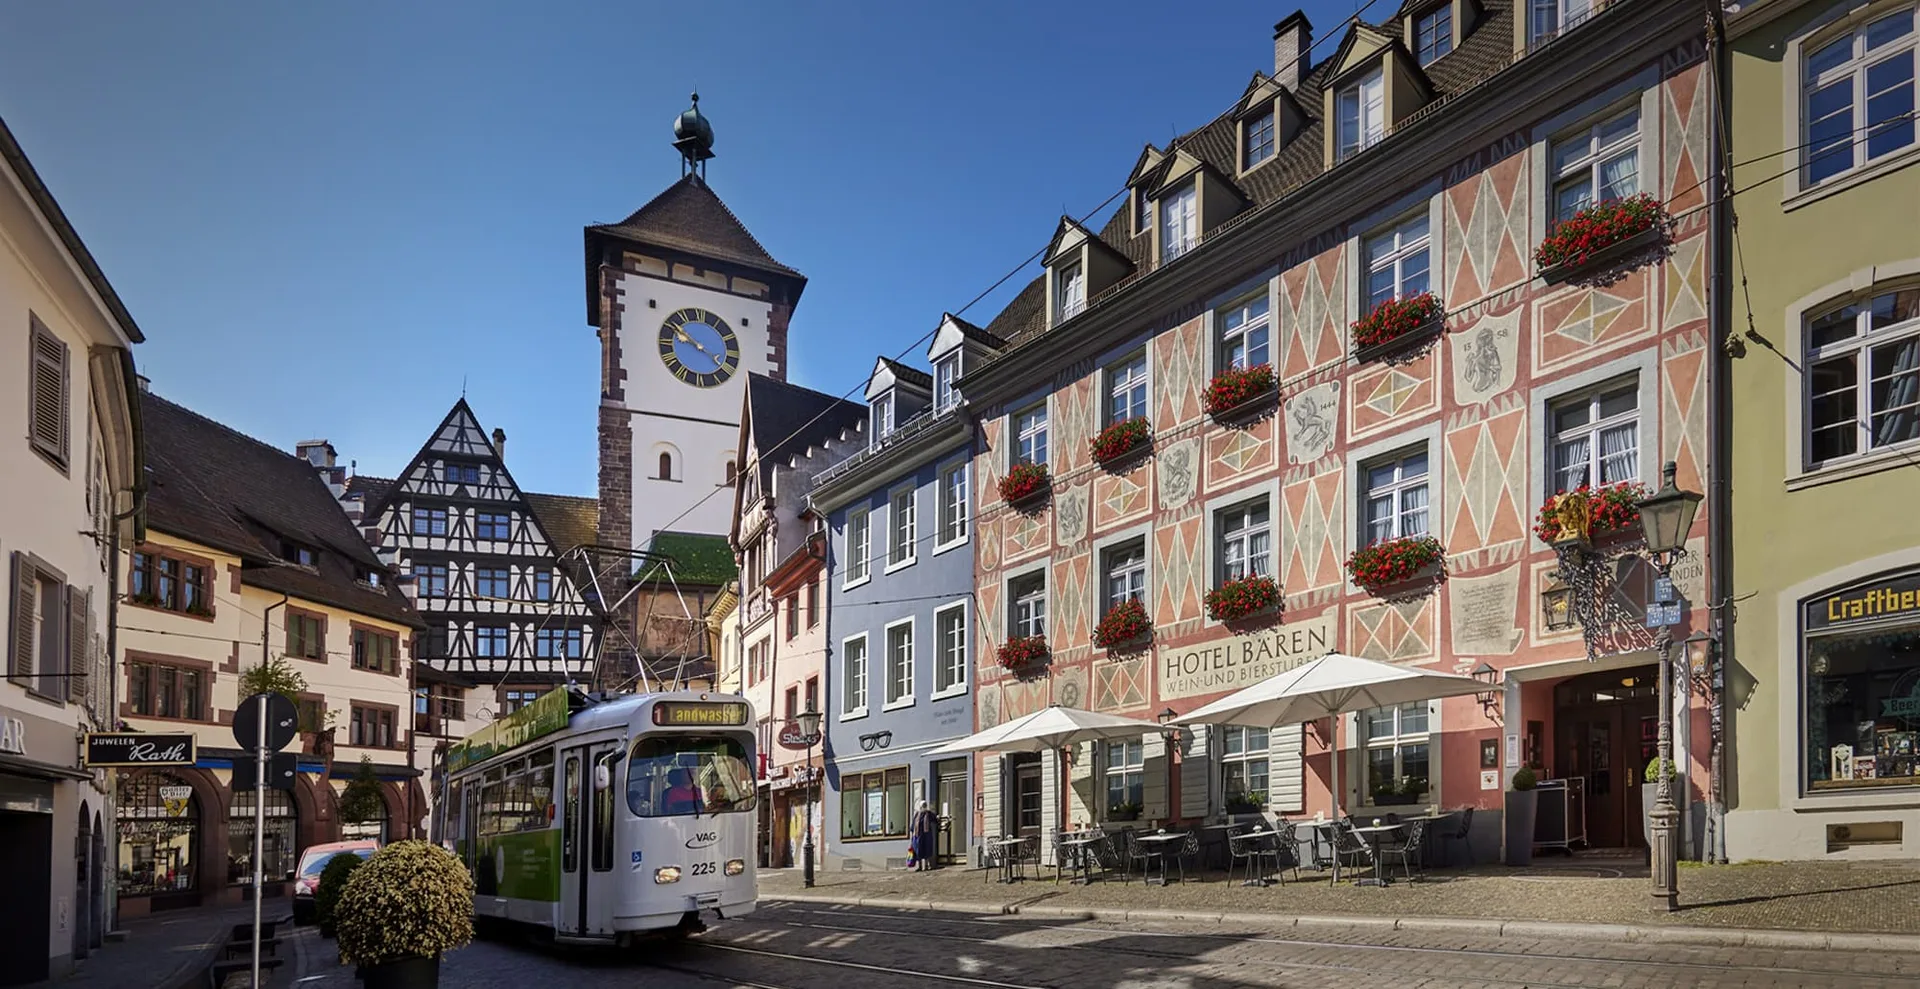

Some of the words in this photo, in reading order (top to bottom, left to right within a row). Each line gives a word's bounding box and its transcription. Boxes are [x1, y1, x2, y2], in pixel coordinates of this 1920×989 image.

[1320, 401, 1336, 411] 1444
[1828, 588, 1920, 621] Craftbe
[1166, 645, 1237, 679] HOTEL
[1242, 625, 1327, 664] BÄREN
[654, 706, 661, 723] 1
[669, 704, 743, 723] Landwasser
[92, 737, 136, 746] JUWELEN
[128, 743, 186, 762] Rath
[695, 831, 717, 842] VAG
[691, 861, 717, 877] 225
